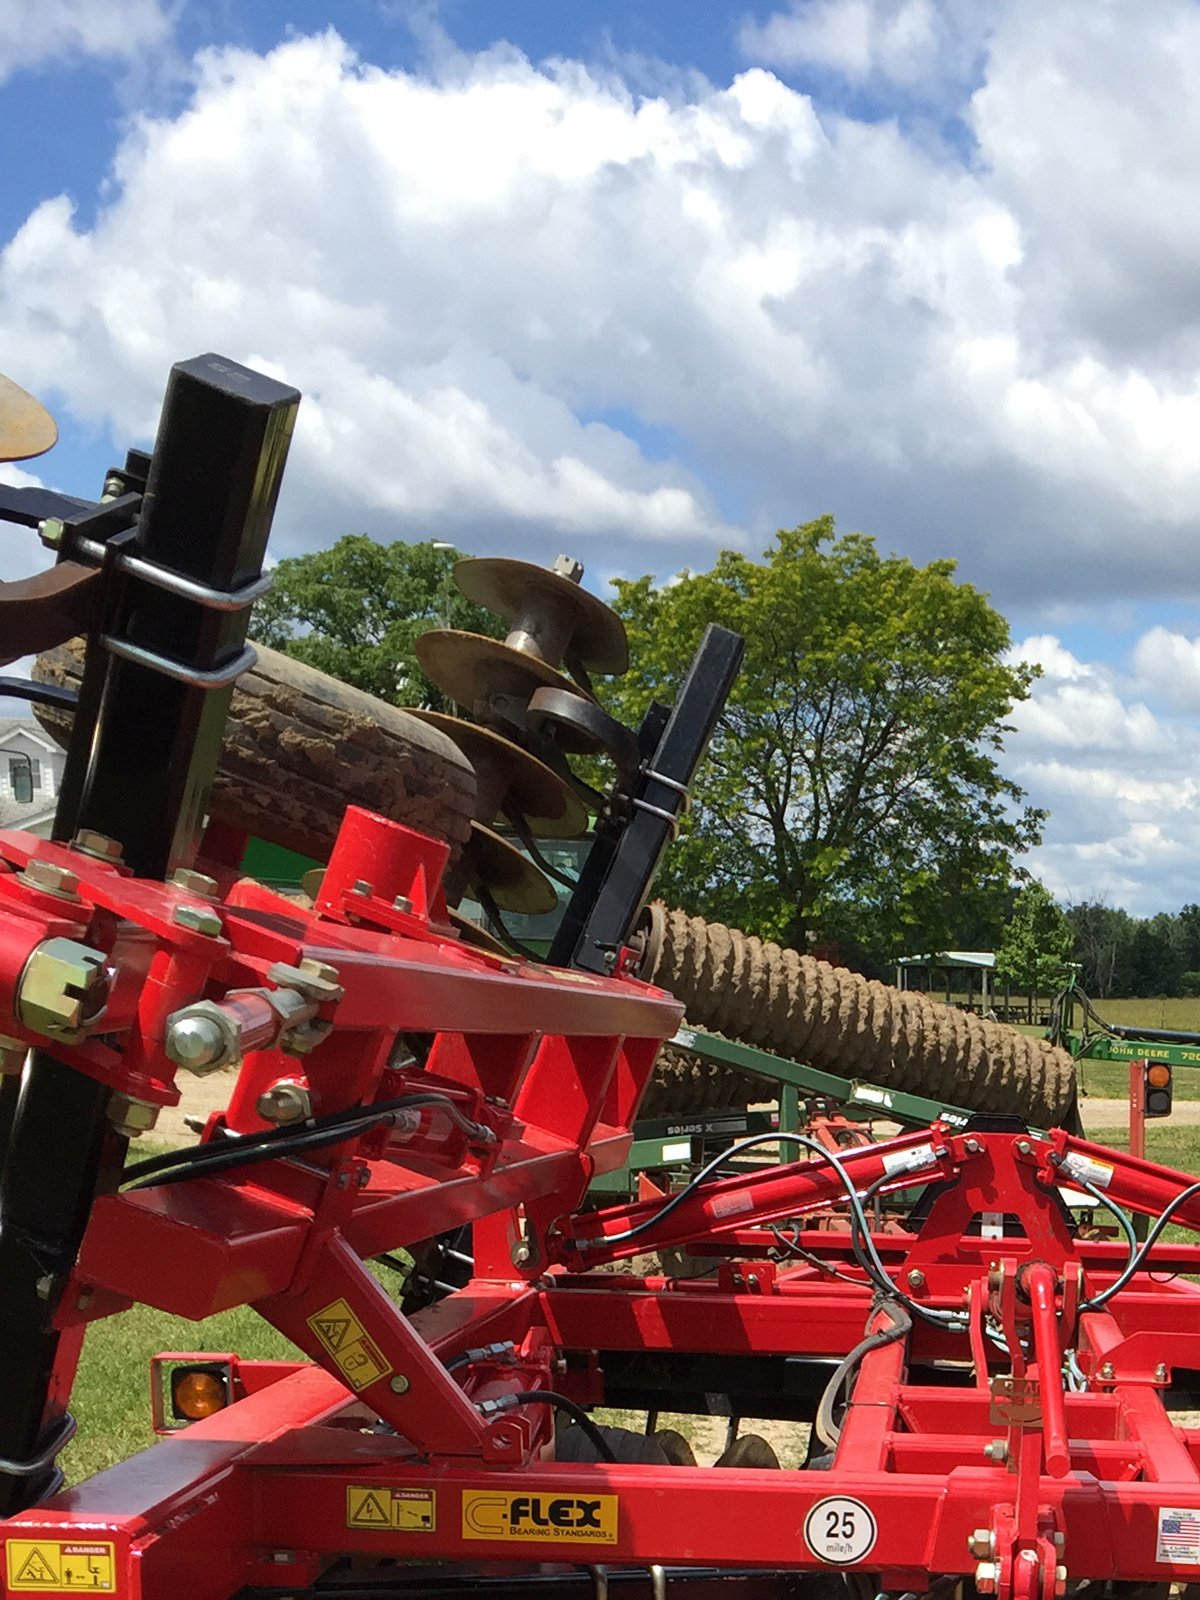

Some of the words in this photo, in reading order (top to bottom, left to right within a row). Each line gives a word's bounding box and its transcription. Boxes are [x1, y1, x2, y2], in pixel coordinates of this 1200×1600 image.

[1108, 1046, 1134, 1056] JOHN
[1137, 1049, 1170, 1059] DEERE
[940, 1112, 969, 1126] ries
[825, 1510, 856, 1539] 25
[510, 1526, 551, 1536] BEARING
[72, 1546, 106, 1554] DANGER
[825, 1543, 853, 1555] mile/h
